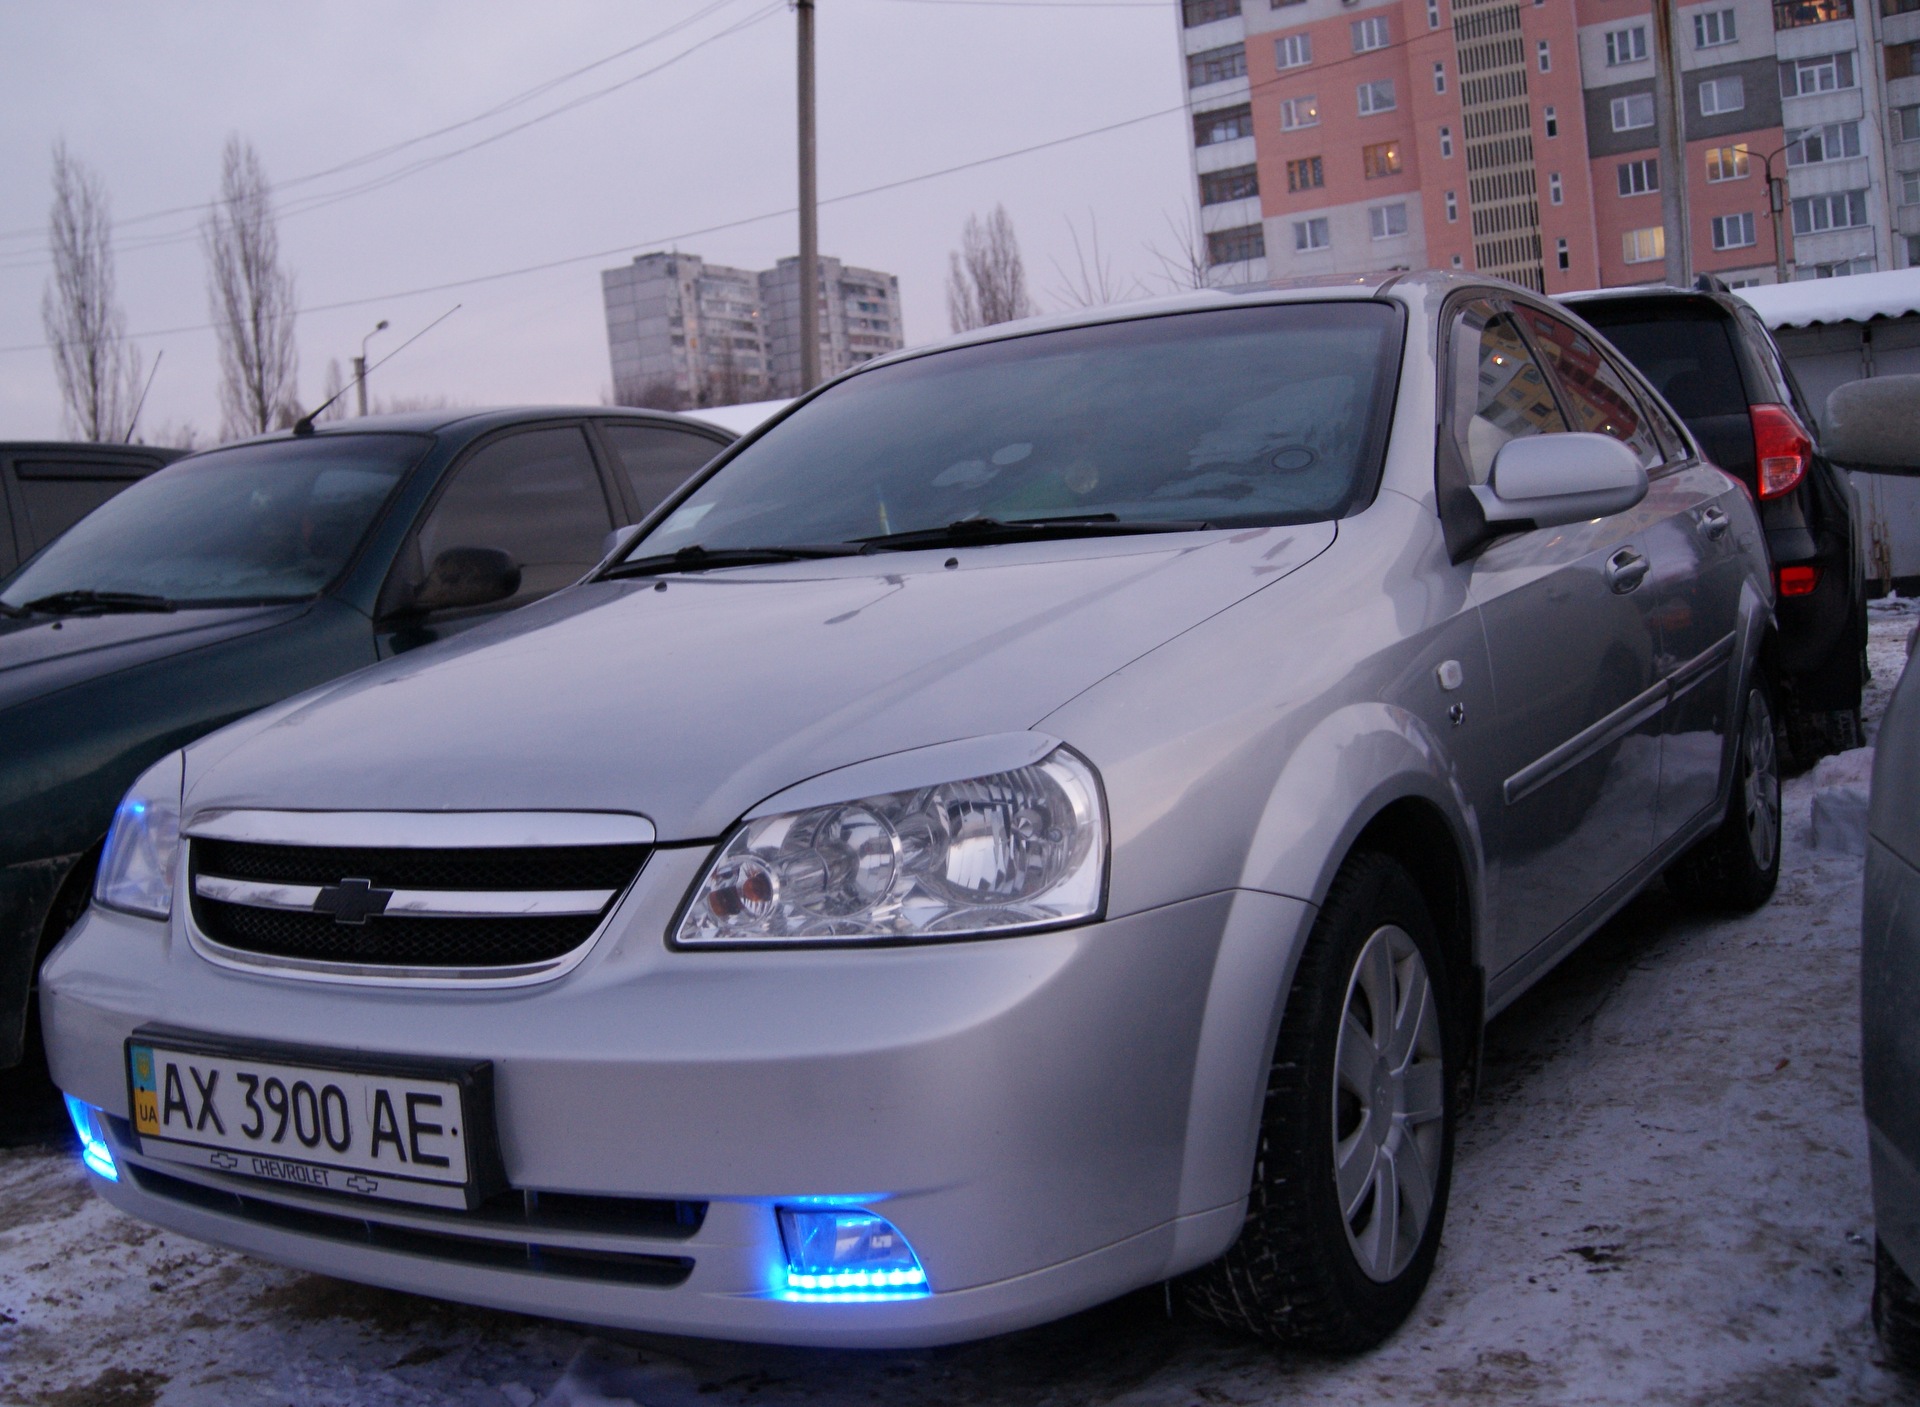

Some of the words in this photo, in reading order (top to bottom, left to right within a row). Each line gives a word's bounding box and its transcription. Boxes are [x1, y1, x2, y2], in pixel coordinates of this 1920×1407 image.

[139, 1103, 158, 1124] UA
[163, 1063, 225, 1134] AX
[236, 1072, 351, 1153] 3900
[371, 1089, 450, 1167] AE
[251, 1158, 329, 1186] CHEVROLET
